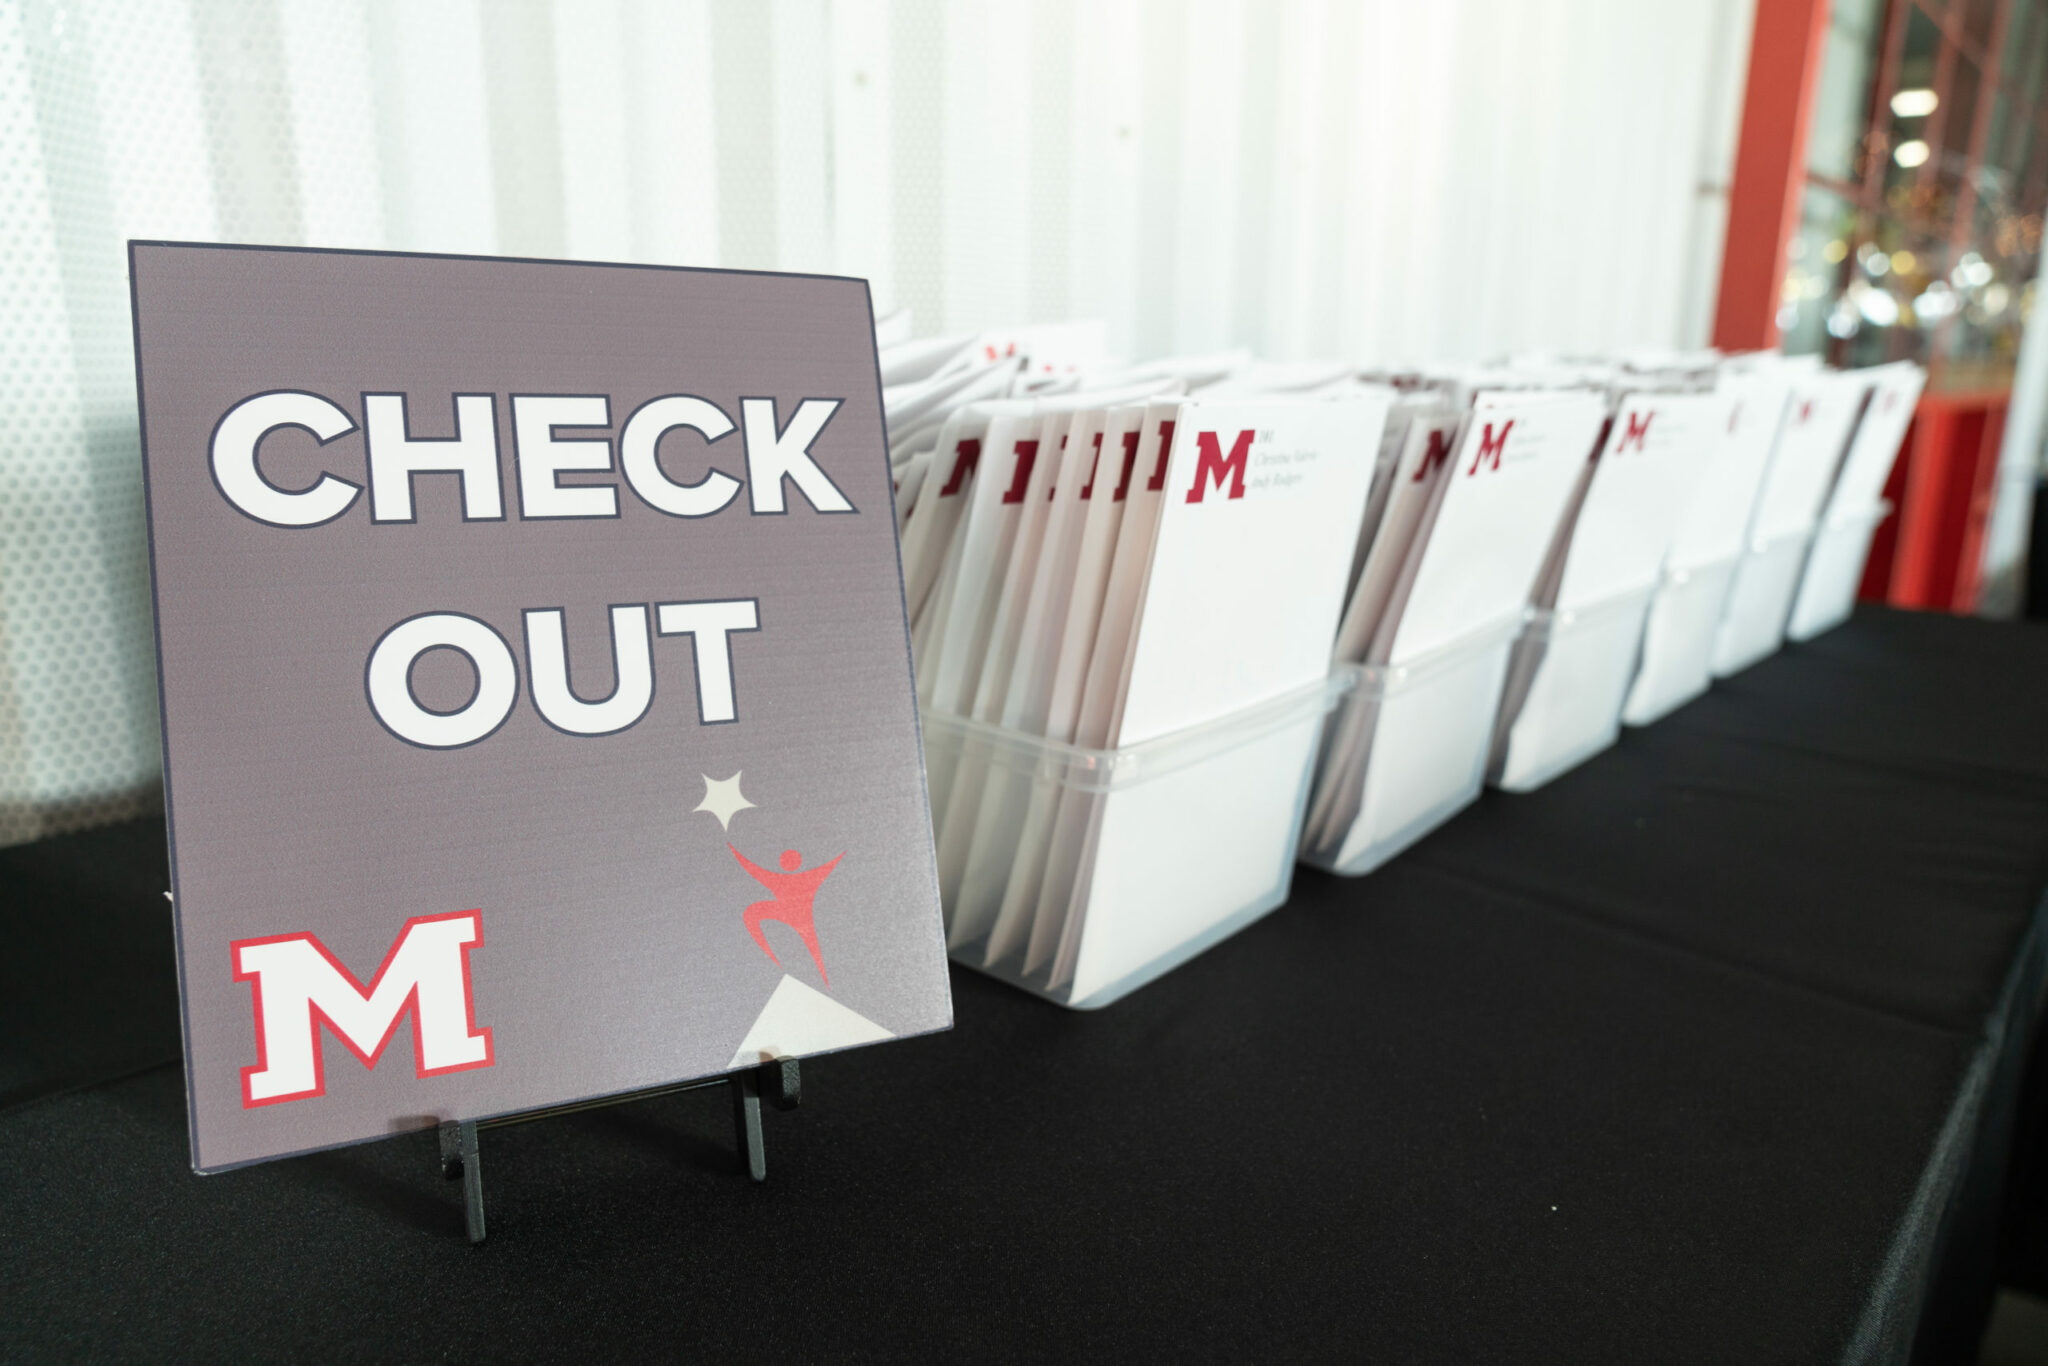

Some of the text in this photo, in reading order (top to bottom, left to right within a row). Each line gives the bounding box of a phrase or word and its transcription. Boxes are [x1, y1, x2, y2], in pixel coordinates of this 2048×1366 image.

[208, 389, 859, 528] CHECK
[1185, 429, 1255, 503] M
[1468, 419, 1514, 476] M
[1615, 410, 1655, 454] M
[364, 598, 761, 750] OUT
[230, 908, 495, 1108] M
